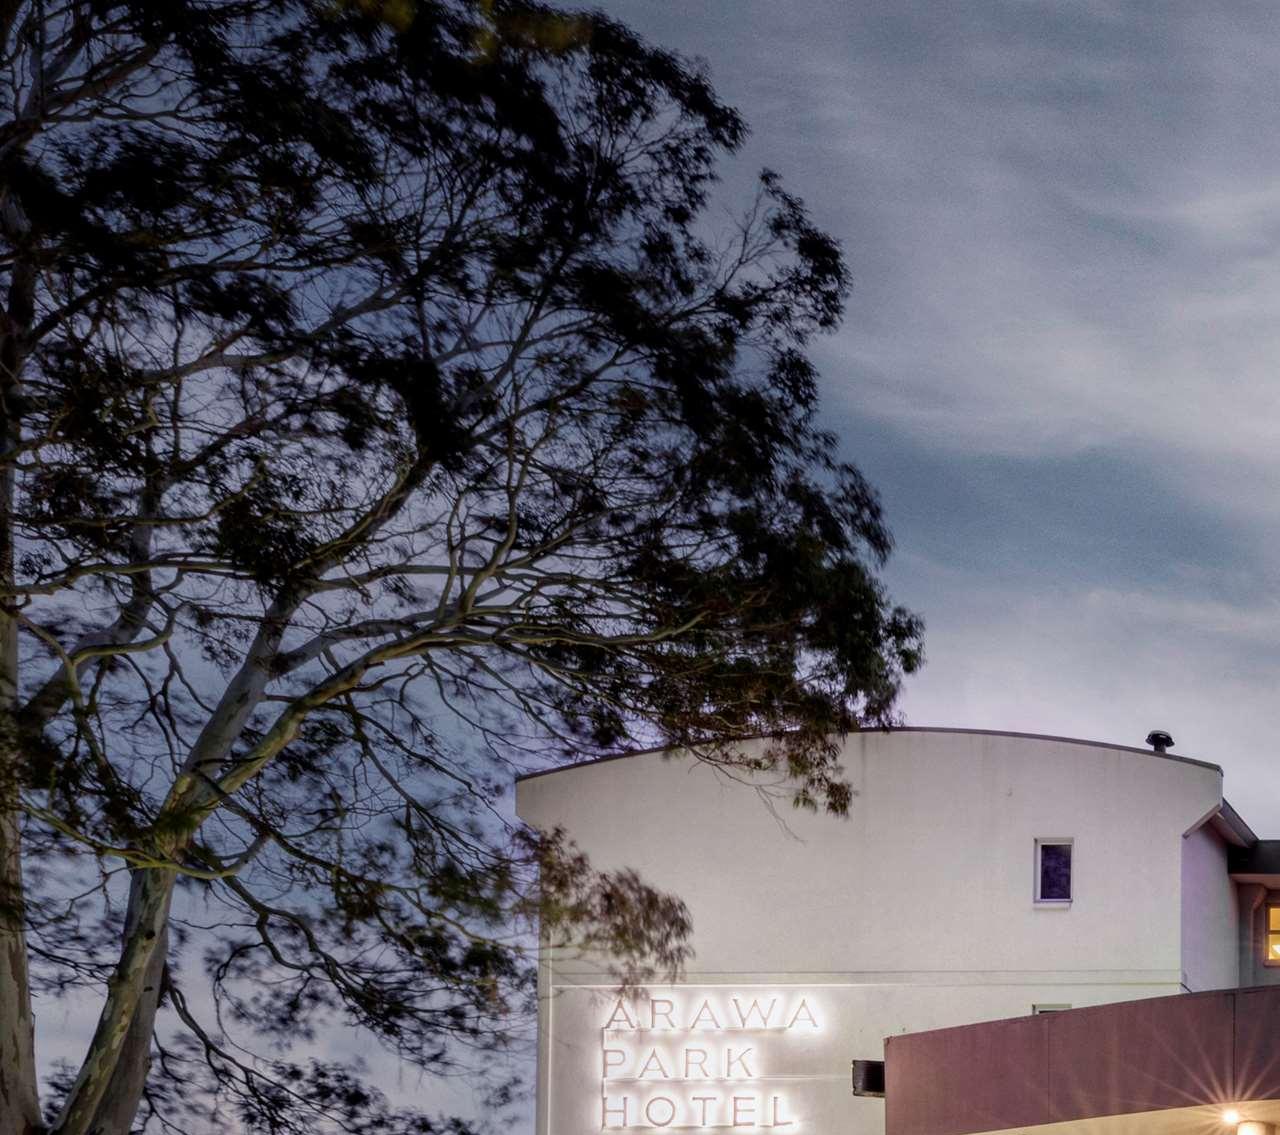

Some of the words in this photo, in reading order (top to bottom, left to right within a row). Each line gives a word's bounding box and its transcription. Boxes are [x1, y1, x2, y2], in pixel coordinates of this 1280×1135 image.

[603, 998, 819, 1029] ARAWA
[602, 1048, 752, 1078] PARK
[602, 1096, 793, 1127] HOTEL
